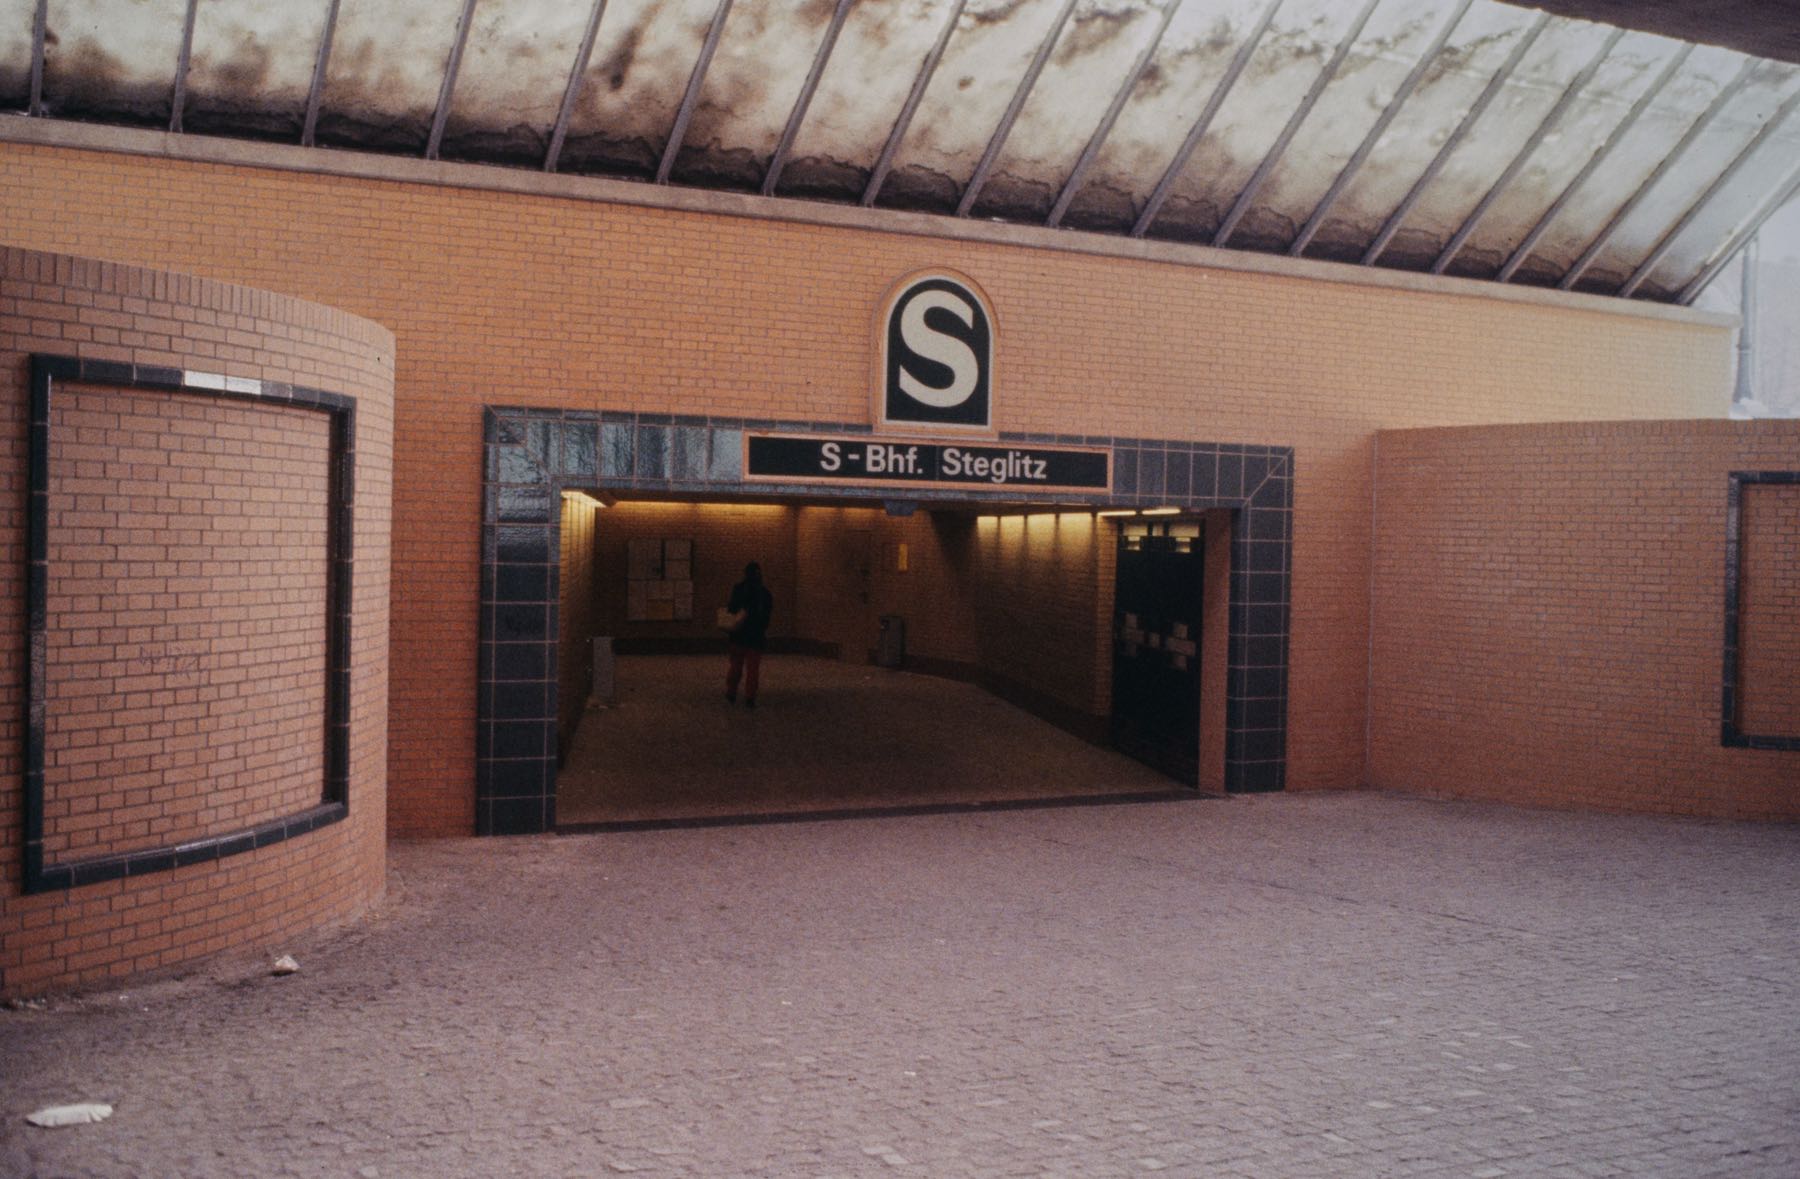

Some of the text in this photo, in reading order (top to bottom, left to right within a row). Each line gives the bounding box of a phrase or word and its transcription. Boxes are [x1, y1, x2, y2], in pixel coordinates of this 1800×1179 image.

[899, 289, 979, 408] S
[820, 442, 1047, 483] S-Bhf. Steglitz
